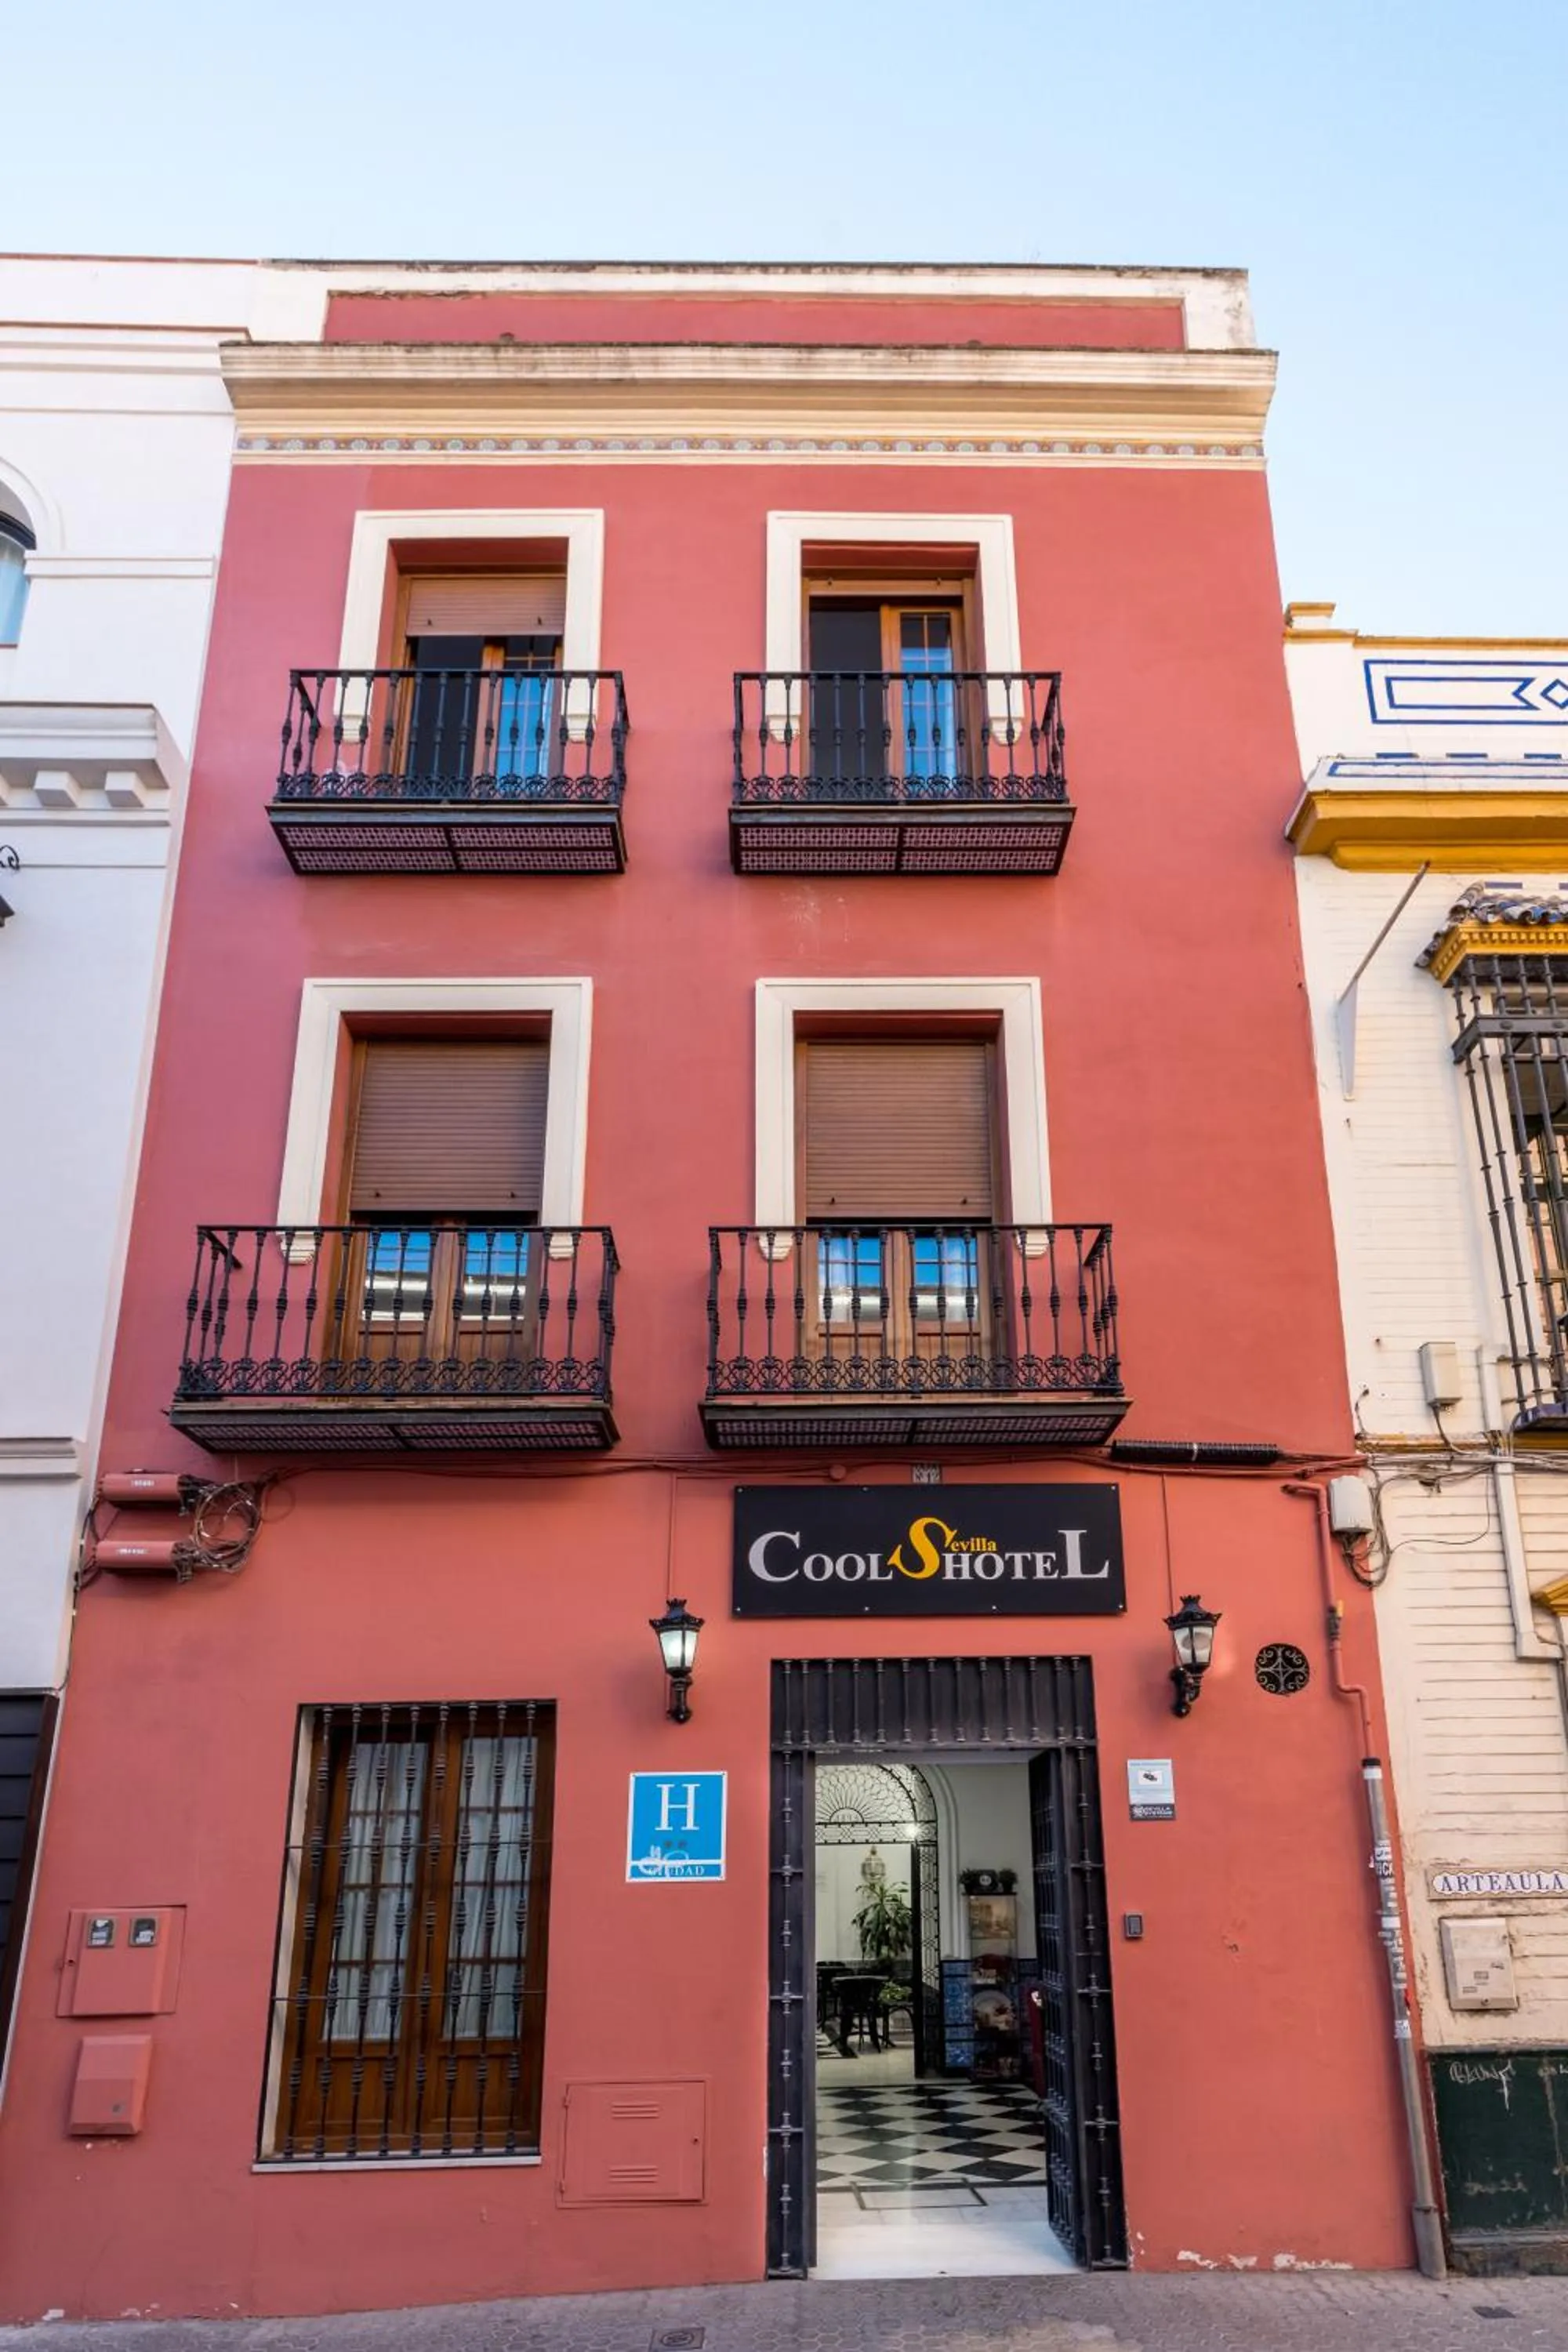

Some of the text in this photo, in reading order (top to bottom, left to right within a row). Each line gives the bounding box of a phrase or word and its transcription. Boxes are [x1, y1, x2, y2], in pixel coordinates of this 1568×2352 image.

[749, 1531, 893, 1581] COOL
[942, 1530, 1109, 1580] HOTEL
[655, 1784, 701, 1831] H
[1441, 1874, 1564, 1891] ARTEAULA
